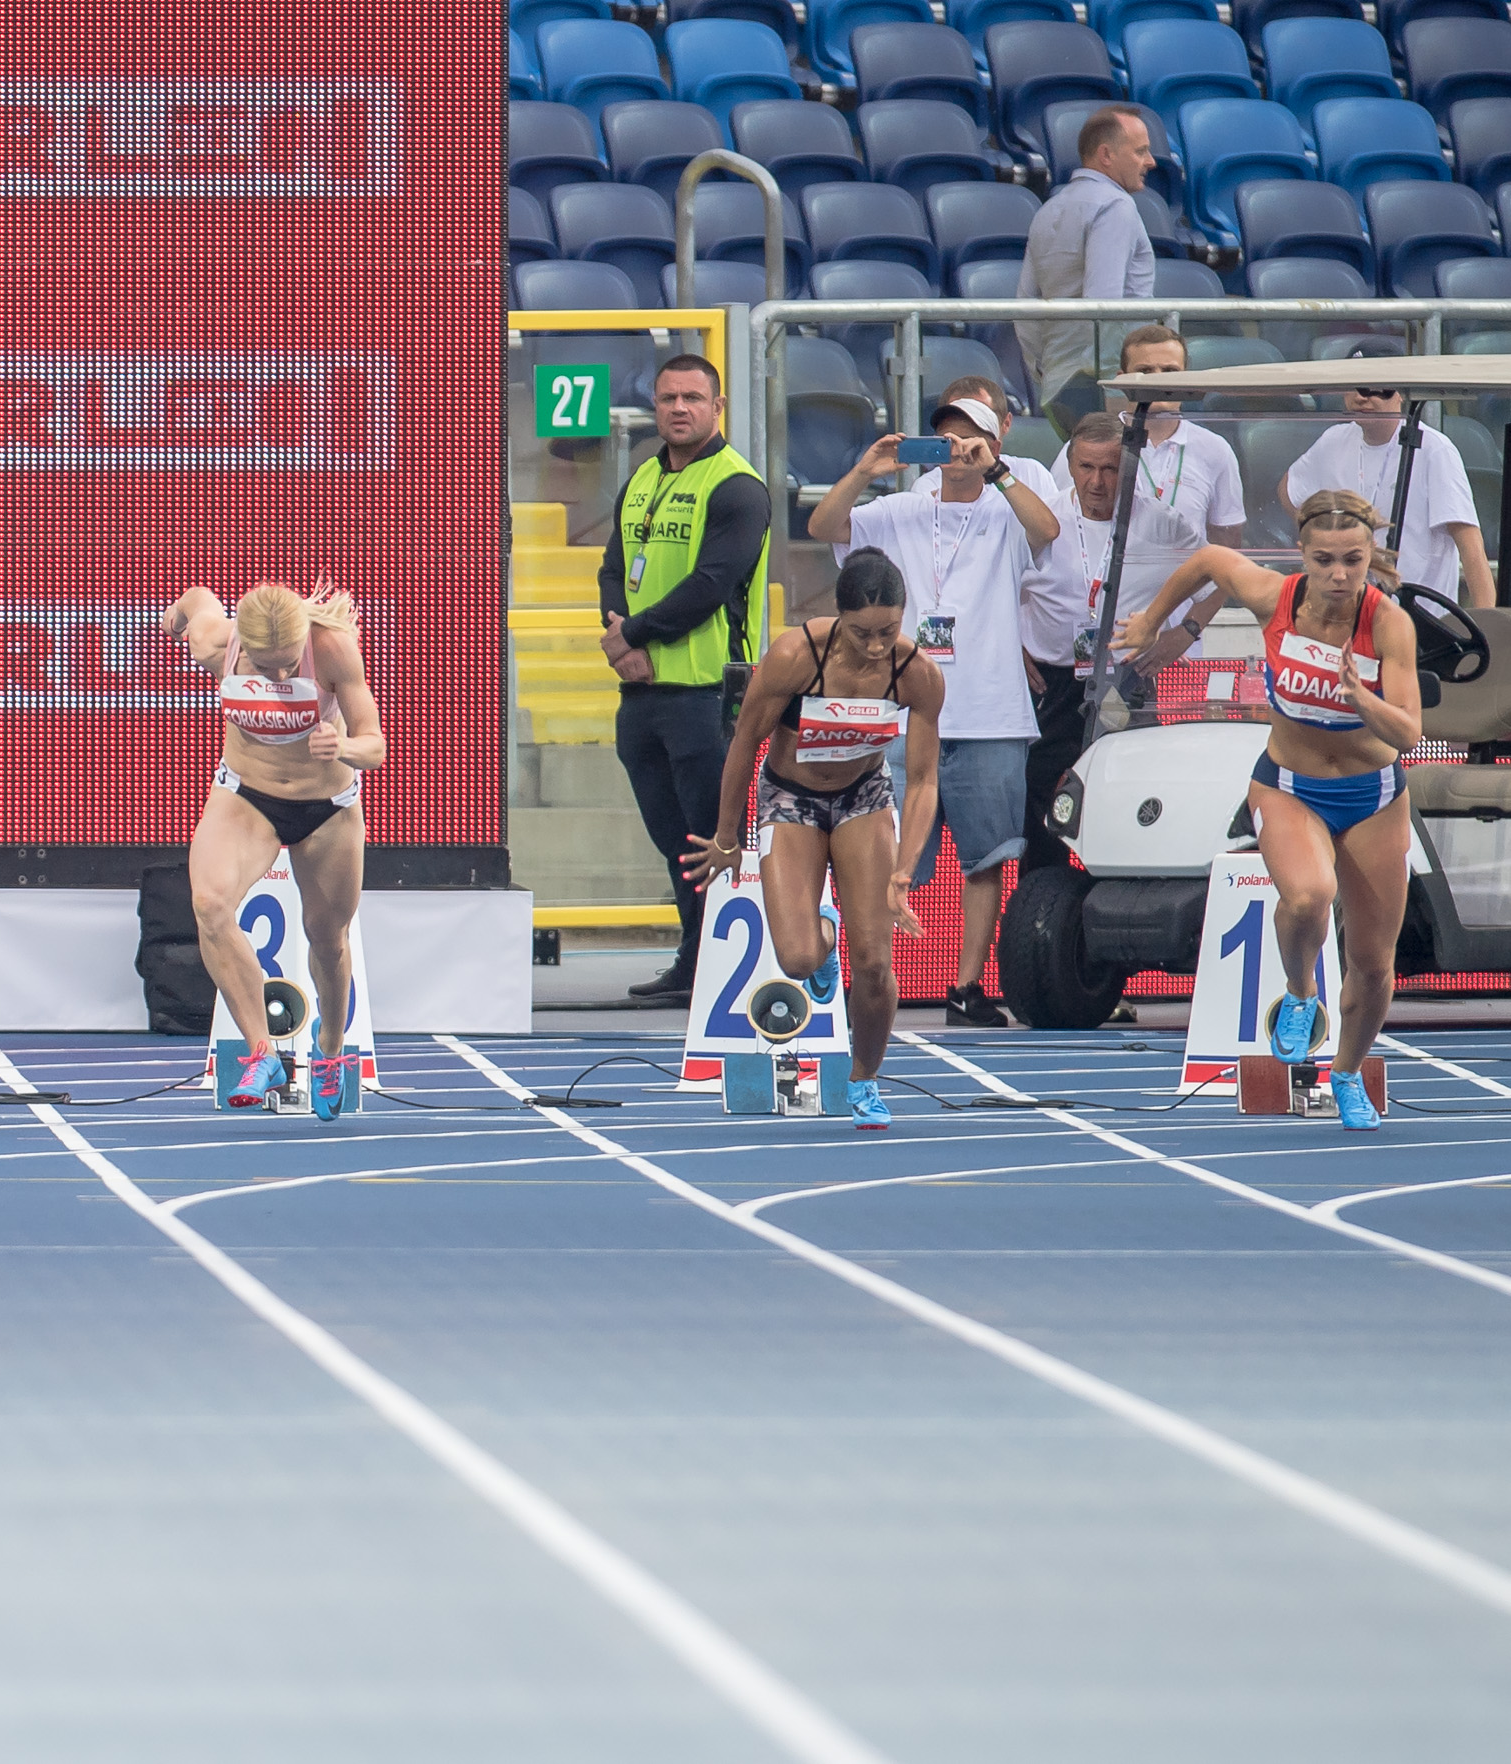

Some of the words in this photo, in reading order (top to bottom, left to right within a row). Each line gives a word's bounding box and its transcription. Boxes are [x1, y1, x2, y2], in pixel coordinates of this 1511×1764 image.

[551, 375, 595, 427] 27
[266, 684, 292, 693] ORLEN
[1276, 667, 1348, 704] ADAM
[848, 706, 878, 715] ORLEN
[262, 868, 290, 881] olanik
[1237, 873, 1273, 888] polanik
[704, 896, 764, 1039] 2
[1220, 900, 1265, 1042] 1
